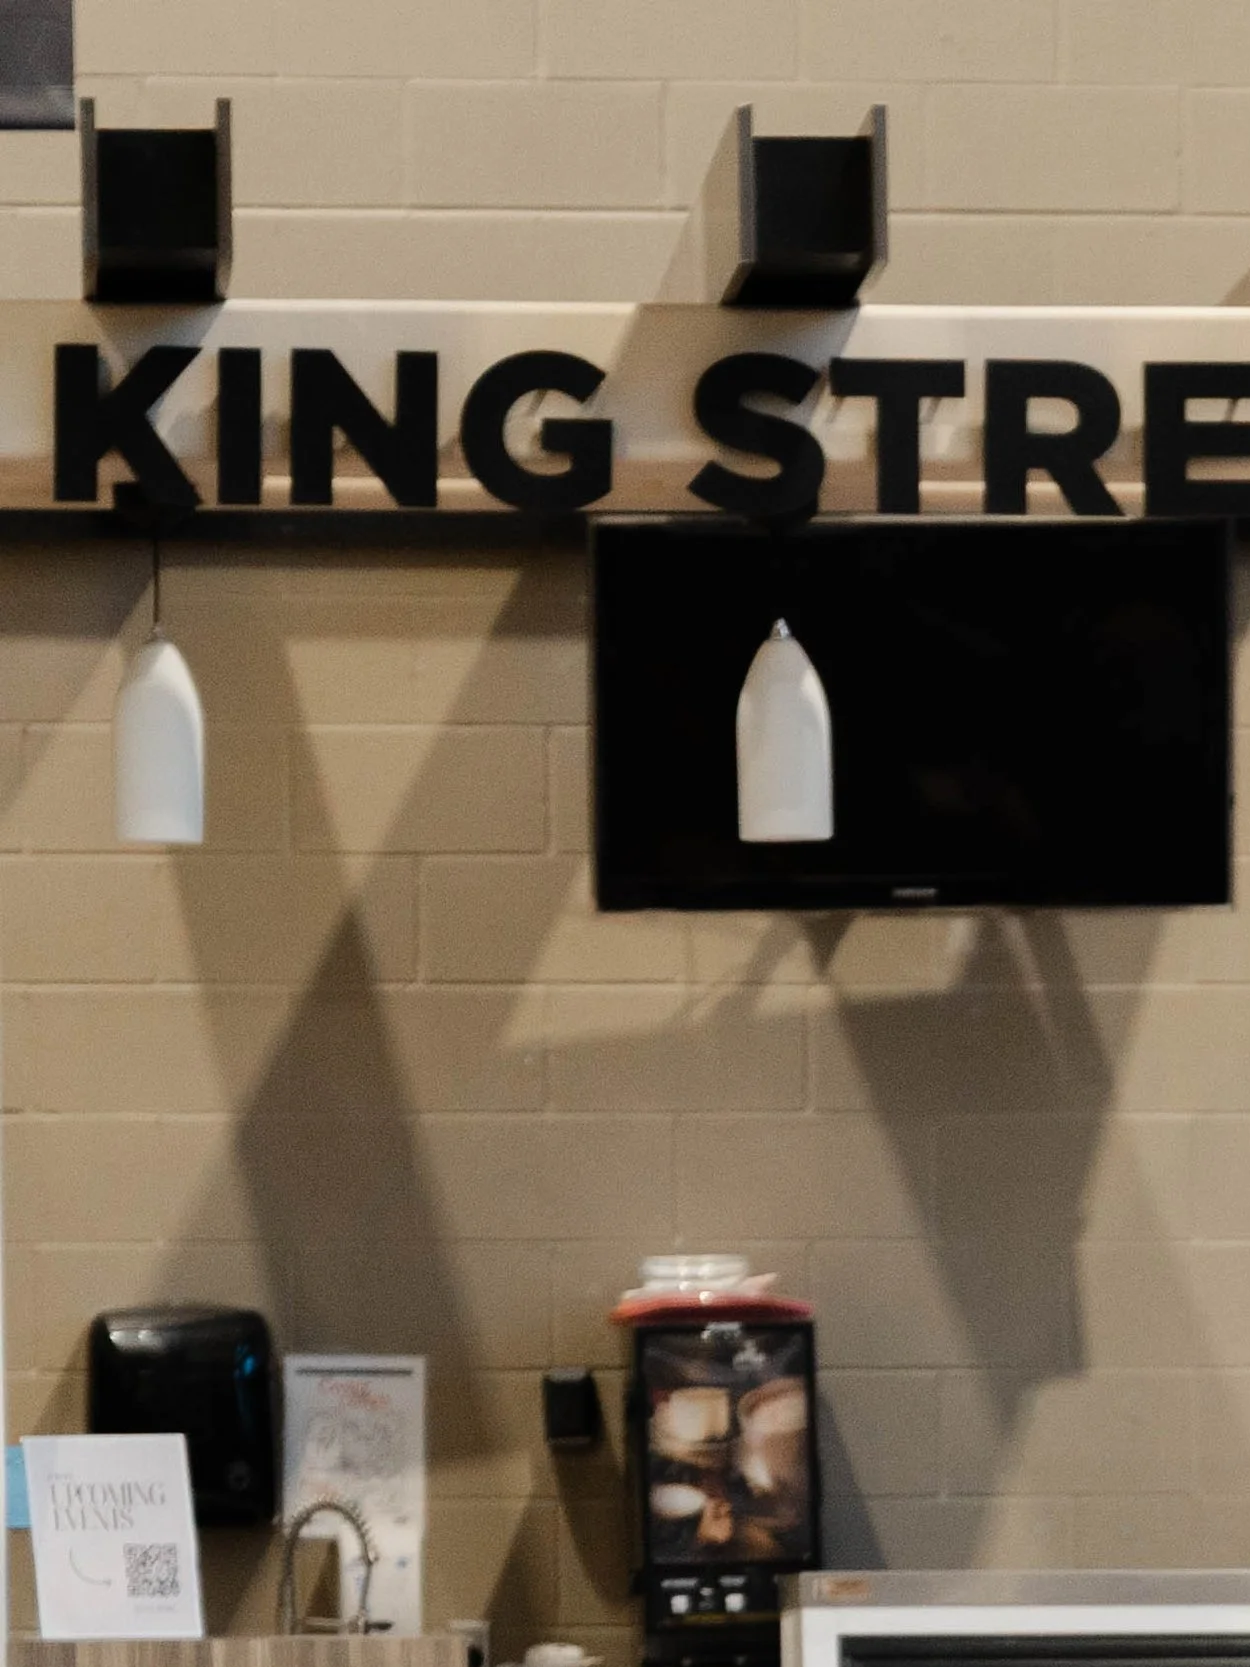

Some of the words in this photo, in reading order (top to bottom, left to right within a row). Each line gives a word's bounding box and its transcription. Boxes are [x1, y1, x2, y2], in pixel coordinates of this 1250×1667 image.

[53, 343, 614, 512] KING
[50, 1481, 166, 1506] UPCOMING
[53, 1508, 134, 1532] EVENTS
